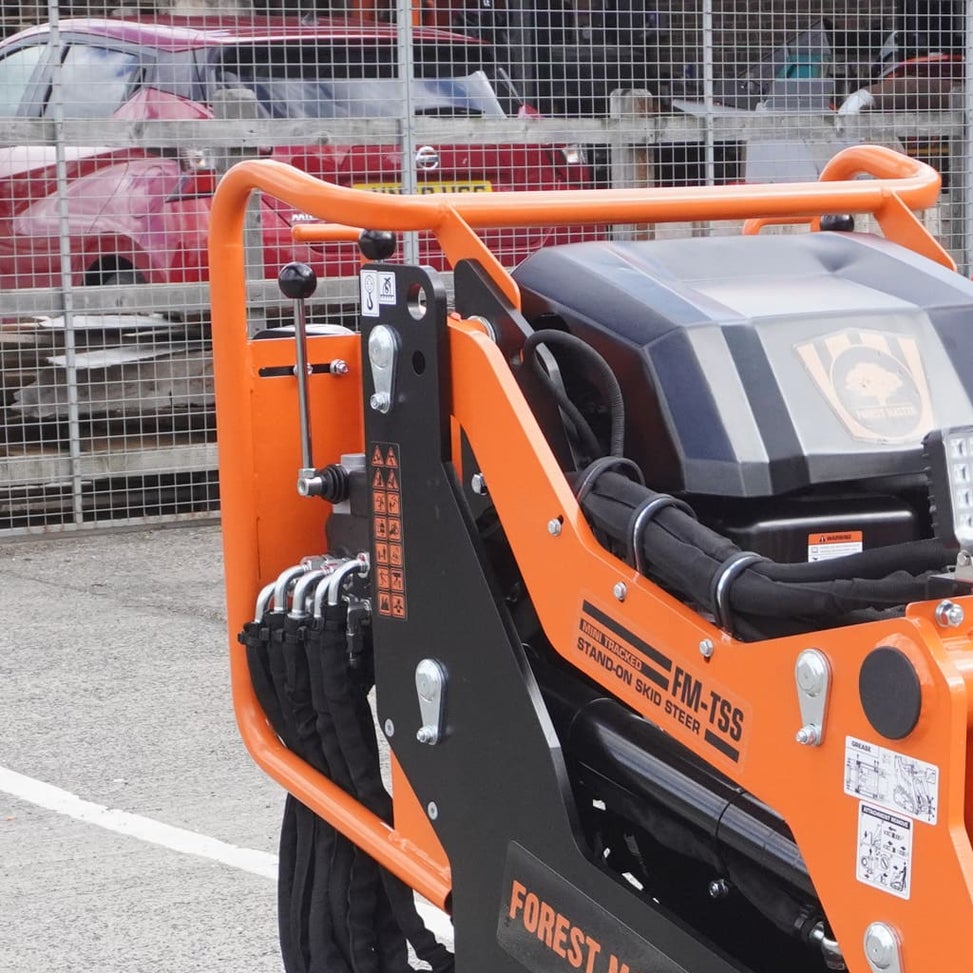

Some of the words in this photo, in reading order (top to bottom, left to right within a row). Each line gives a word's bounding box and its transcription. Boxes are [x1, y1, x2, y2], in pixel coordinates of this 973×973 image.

[582, 621, 603, 644] MINI
[604, 636, 643, 672] TRACKED
[577, 637, 633, 686] STAND-ON
[635, 678, 662, 707] SKID
[664, 699, 700, 735] STEER
[671, 666, 744, 742] FM-TSS
[851, 740, 871, 752] GREASE
